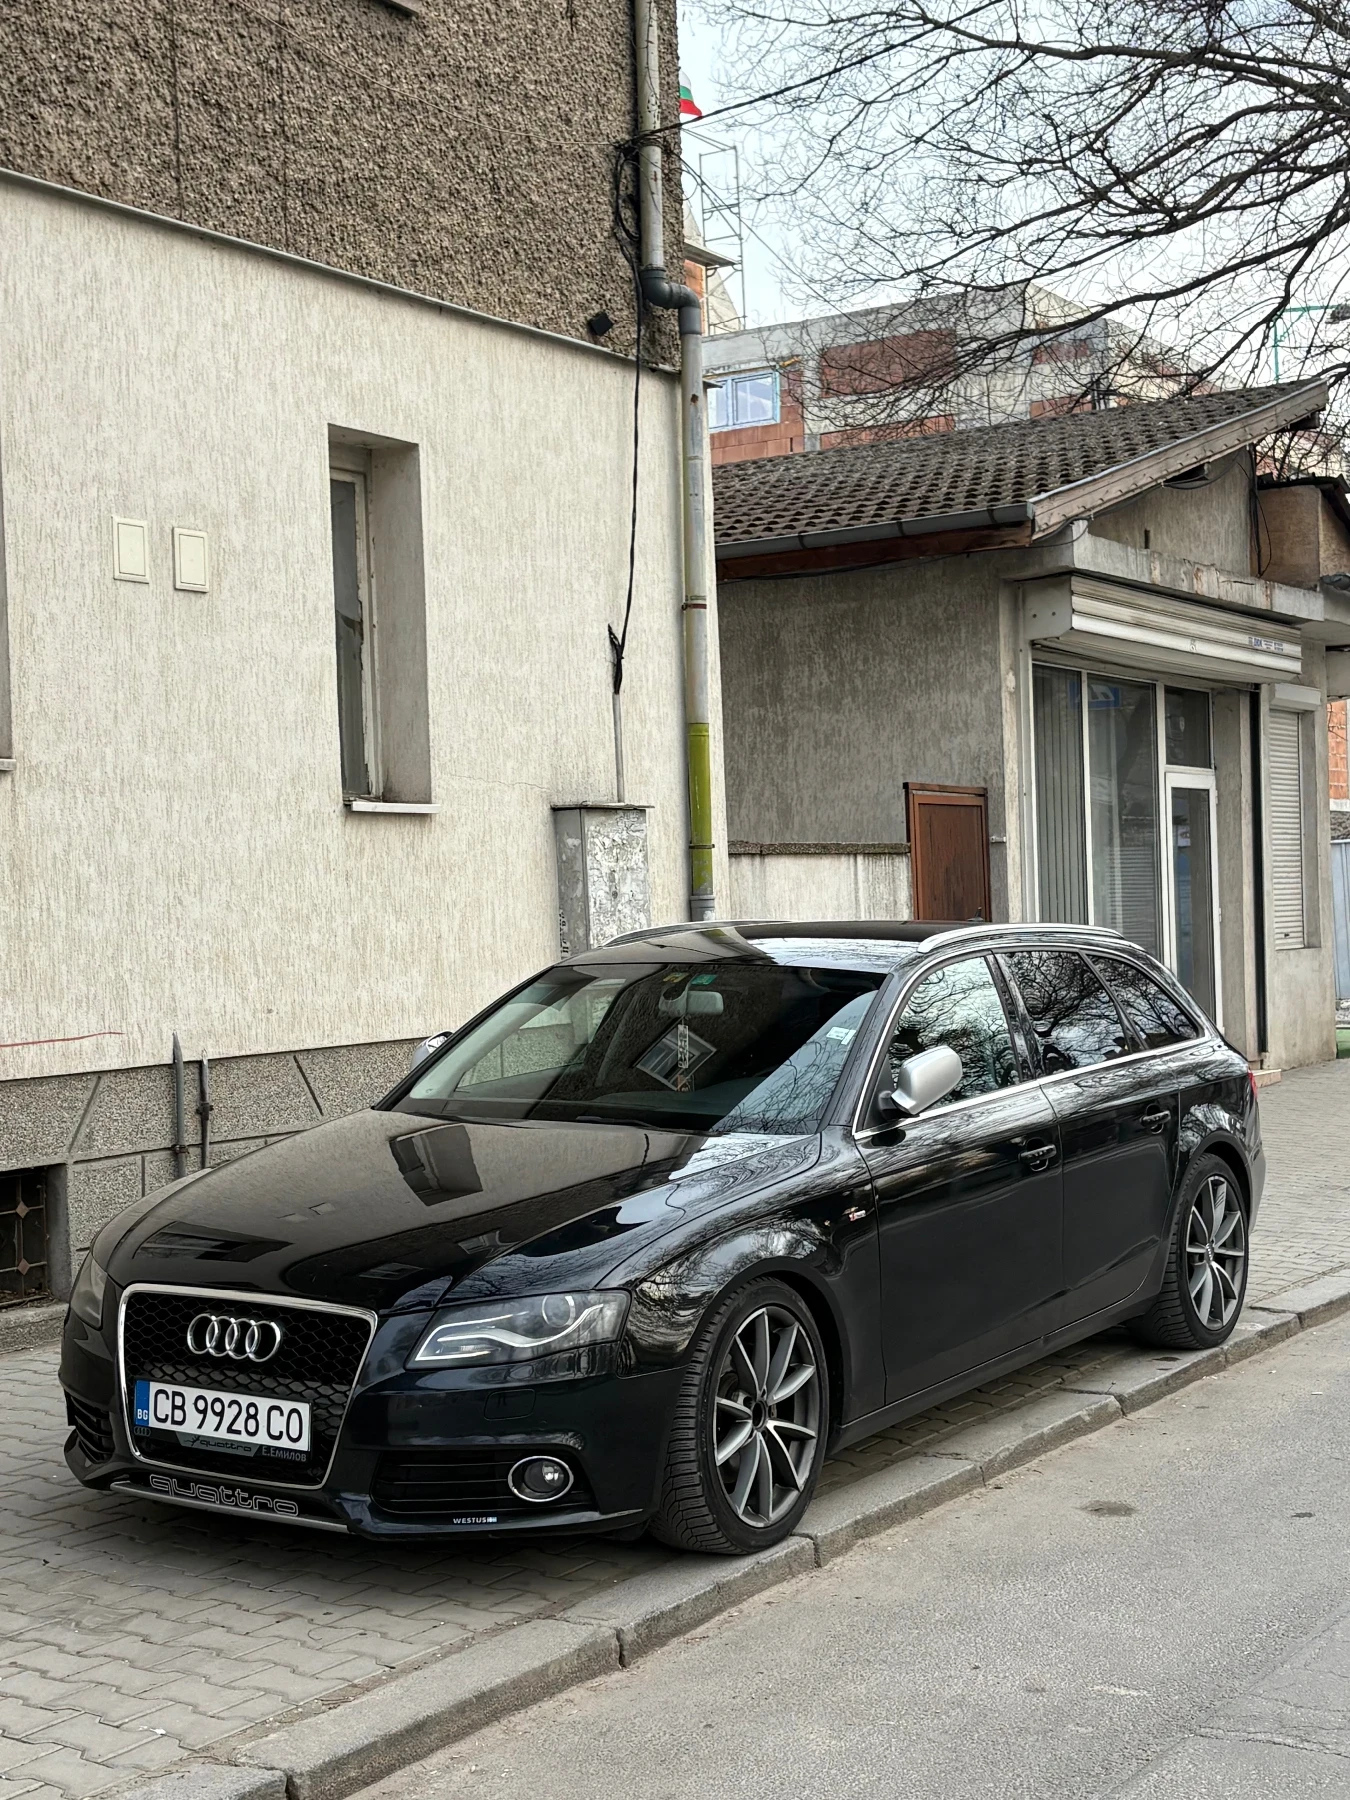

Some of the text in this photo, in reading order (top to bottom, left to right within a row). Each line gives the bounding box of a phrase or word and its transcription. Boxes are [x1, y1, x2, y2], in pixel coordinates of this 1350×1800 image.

[137, 1408, 149, 1420] BG
[153, 1389, 304, 1443] CB 9928 CO
[200, 1439, 252, 1453] quattro
[149, 1474, 299, 1517] quattro
